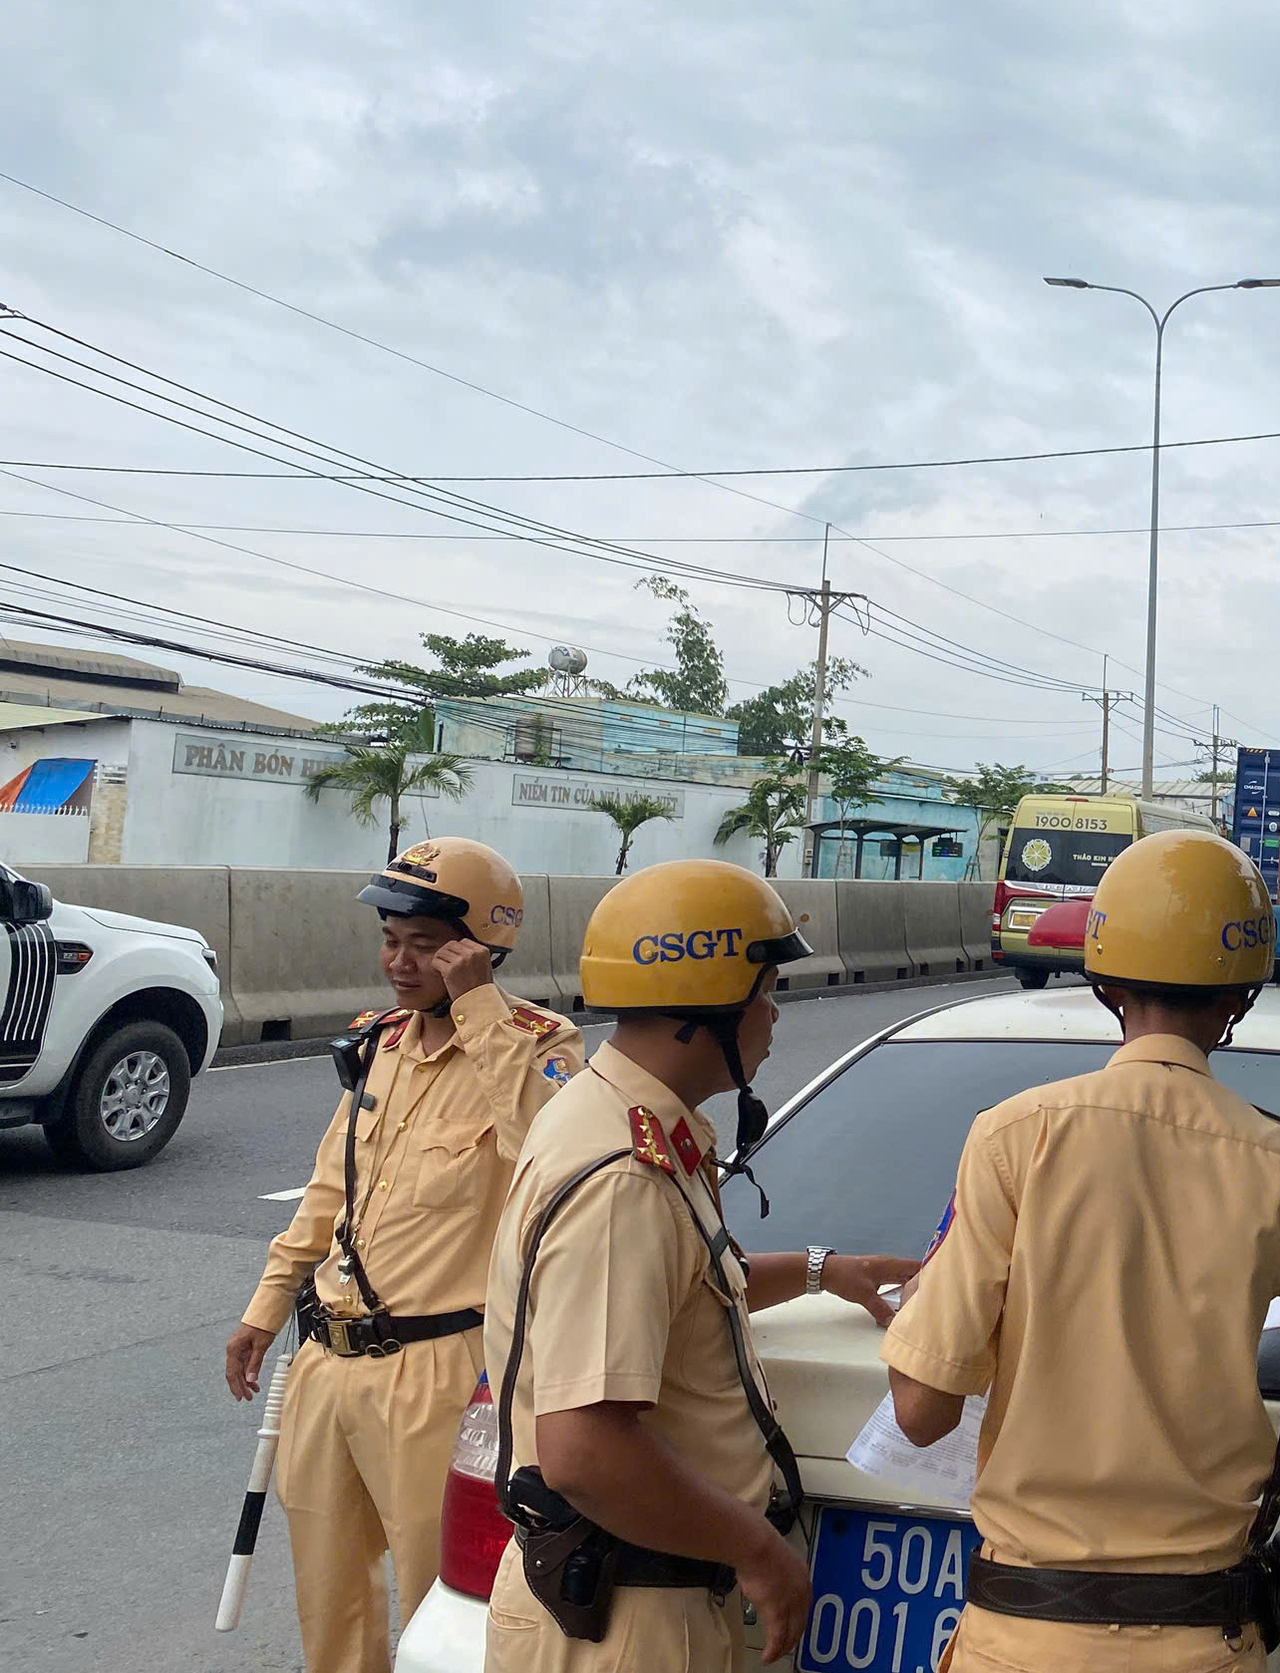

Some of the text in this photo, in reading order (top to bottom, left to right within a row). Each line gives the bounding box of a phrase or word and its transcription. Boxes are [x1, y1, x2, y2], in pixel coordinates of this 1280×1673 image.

[184, 743, 245, 771] PHÂN
[252, 749, 296, 777] BÓN
[551, 785, 571, 804] TIN
[1035, 815, 1108, 831] 1900 8153
[632, 928, 742, 965] CSGT
[861, 1520, 964, 1600] 50A
